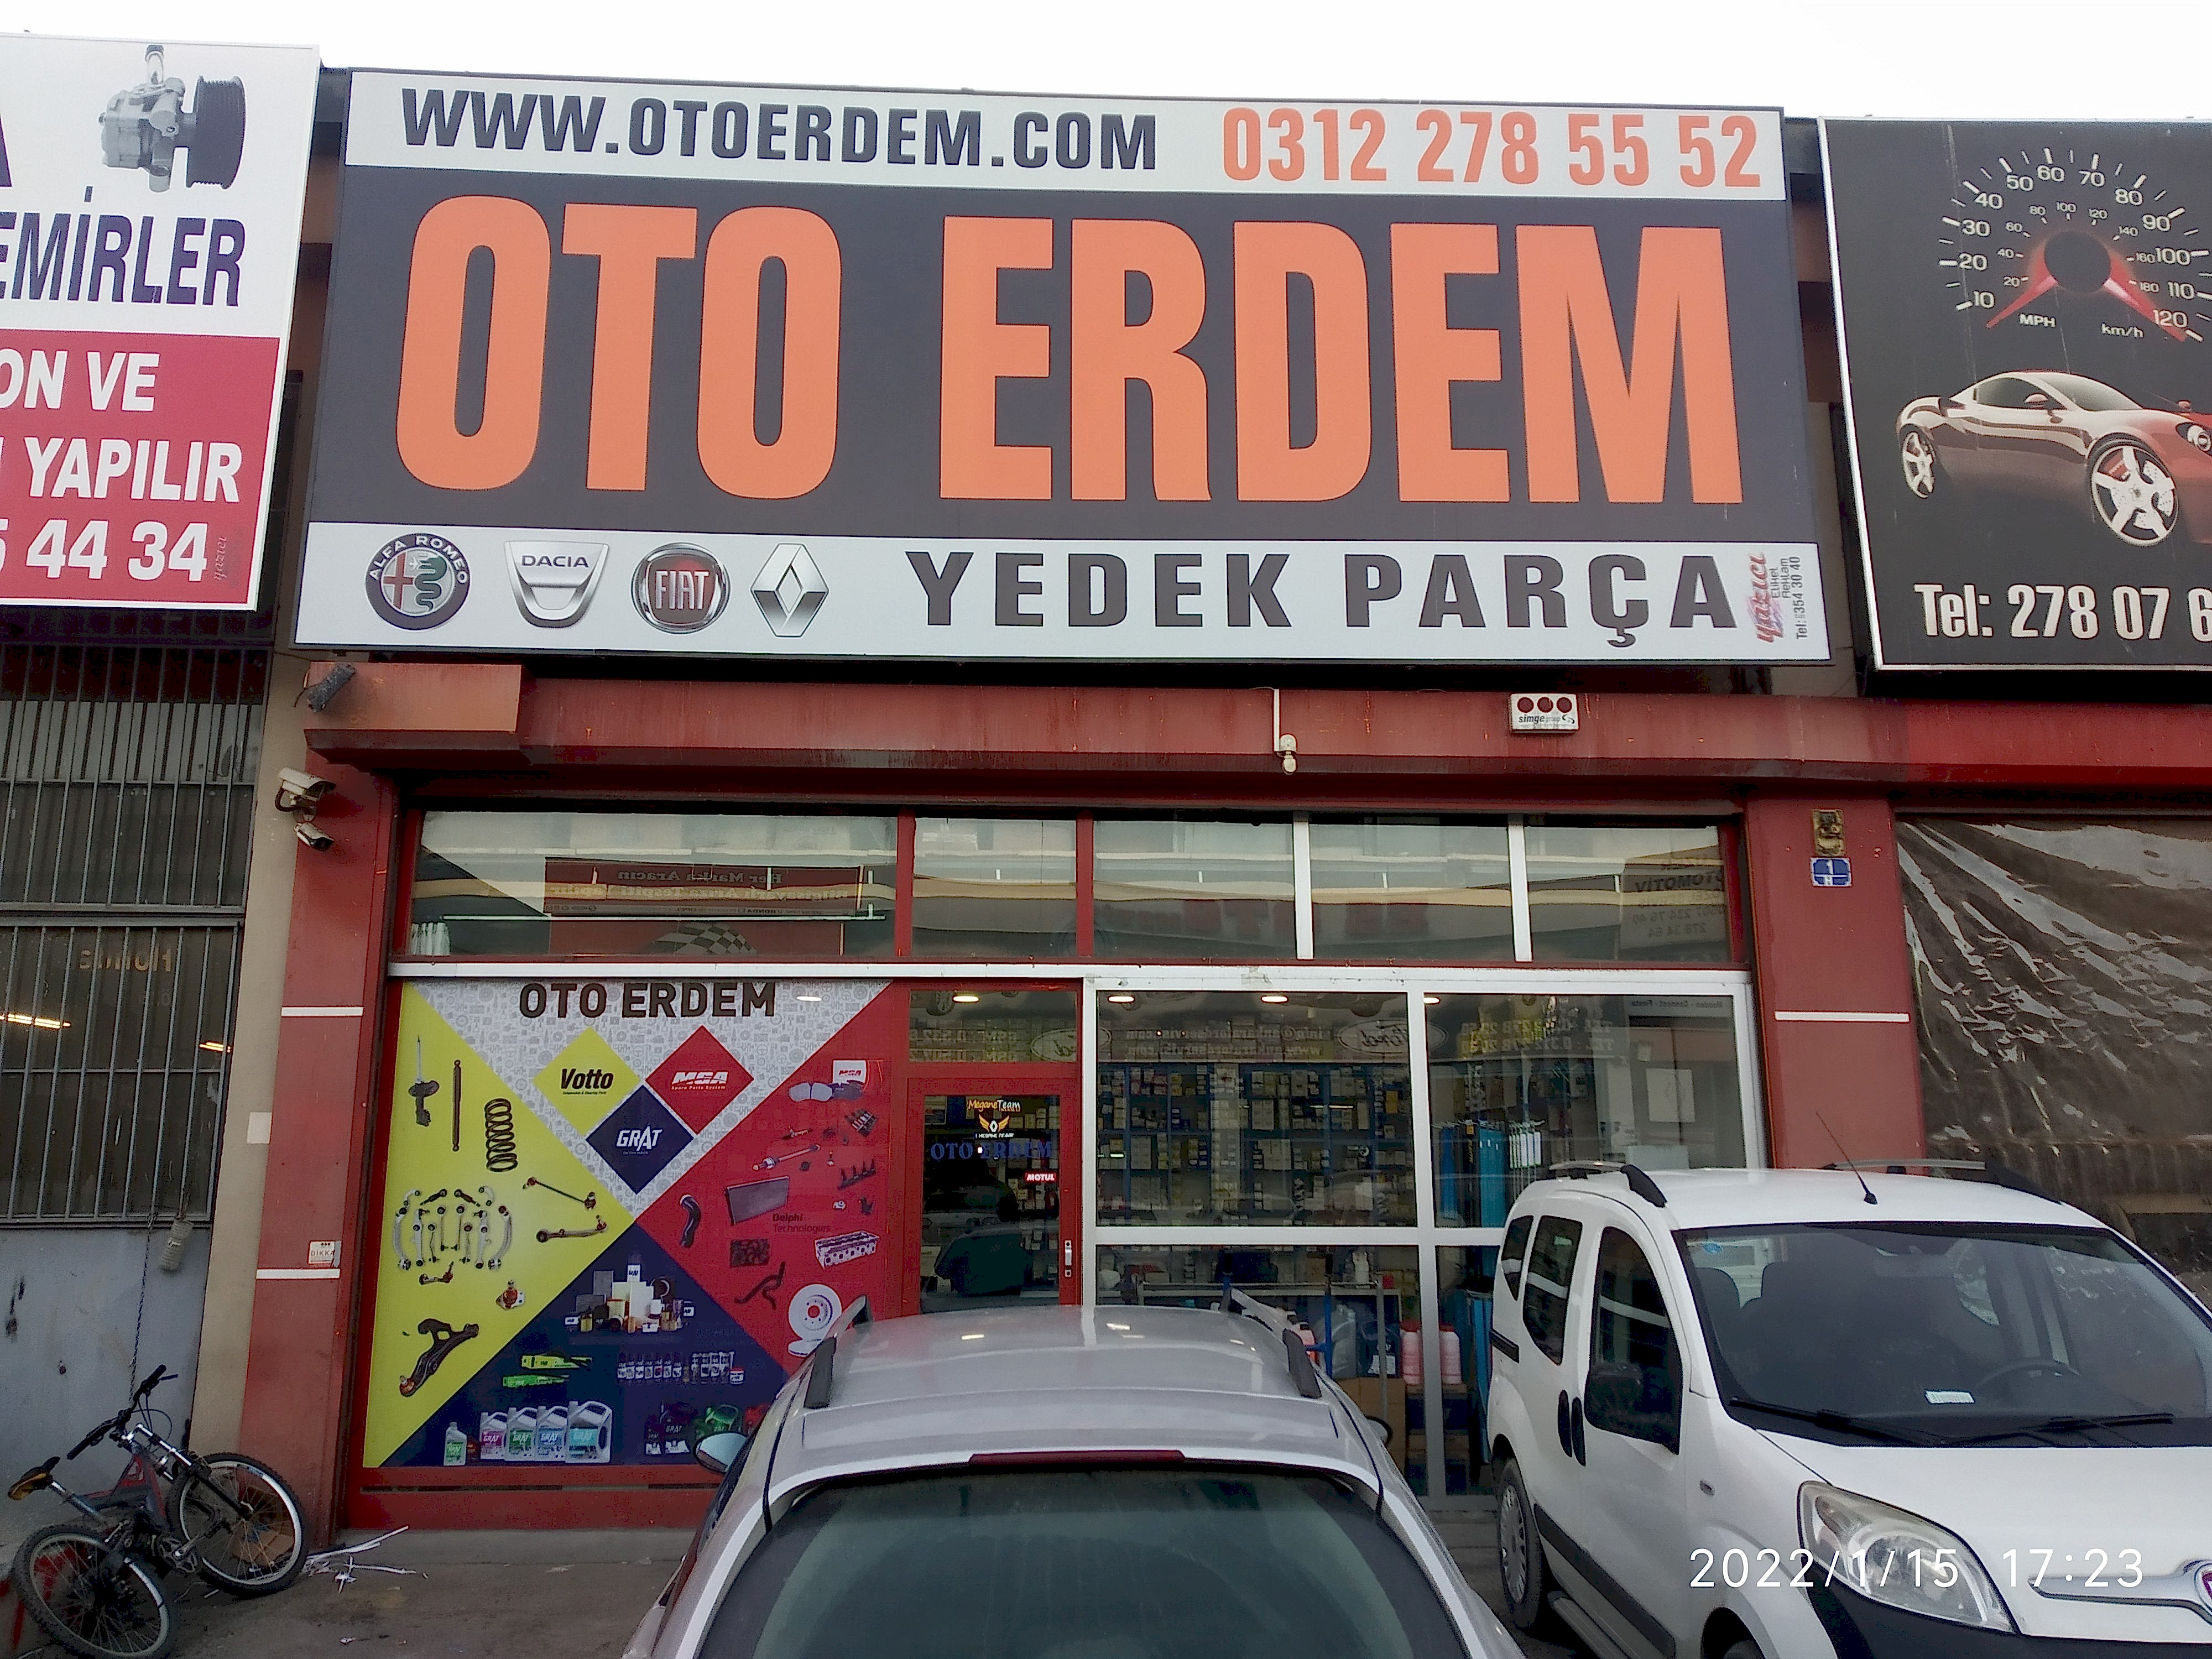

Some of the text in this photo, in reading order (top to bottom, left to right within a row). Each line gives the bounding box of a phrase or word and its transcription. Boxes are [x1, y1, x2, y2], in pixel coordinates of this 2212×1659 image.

[401, 87, 1762, 188] WWW.OTOERDEM.COM 0312 278 55 52
[2037, 165, 2065, 183] 60
[2079, 170, 2105, 187] 70
[2006, 175, 2034, 191] 50
[1974, 192, 2003, 209] 40
[2115, 188, 2143, 206] 80
[2030, 205, 2046, 216] 80
[2056, 201, 2077, 213] 100
[2088, 208, 2108, 220] 120
[1961, 220, 1991, 237] 30
[2005, 221, 2023, 233] 60
[2119, 225, 2139, 237] 140
[2142, 215, 2171, 232] 90
[1997, 248, 2015, 259] 40
[2135, 252, 2156, 263] 160
[2154, 247, 2191, 266] 100
[1959, 254, 1988, 272] 20
[2004, 276, 2021, 288] 20
[2138, 281, 2159, 293] 180
[2167, 281, 2195, 300] 110
[1973, 291, 1995, 308] 10
[2019, 314, 2056, 328] MPH
[2154, 310, 2188, 329] 120
[2101, 323, 2144, 339] km/h
[395, 195, 1744, 504] OTO ERDEM
[86, 351, 160, 412] VE
[24, 436, 242, 503] YAPILIR
[25, 518, 109, 580] 44
[127, 520, 209, 582] 34
[368, 534, 469, 585] ALFA ROMEO
[521, 554, 589, 568] DACIA
[1788, 556, 1801, 571] 40
[1791, 574, 1803, 588] 30
[655, 569, 709, 611] FIAT
[905, 551, 1738, 648] YEDEK PARÇA
[1792, 593, 1806, 614] 354
[1913, 583, 2212, 642] Tel: 278 07 6
[1518, 713, 1545, 724] simge
[519, 981, 775, 1019] OTO ERDEM
[561, 1068, 614, 1089] Votto
[616, 1125, 664, 1152] GRAT
[930, 1140, 1052, 1160] OTO ERDEM
[1025, 1173, 1056, 1181] MOTUL
[772, 1213, 803, 1224] Delphi
